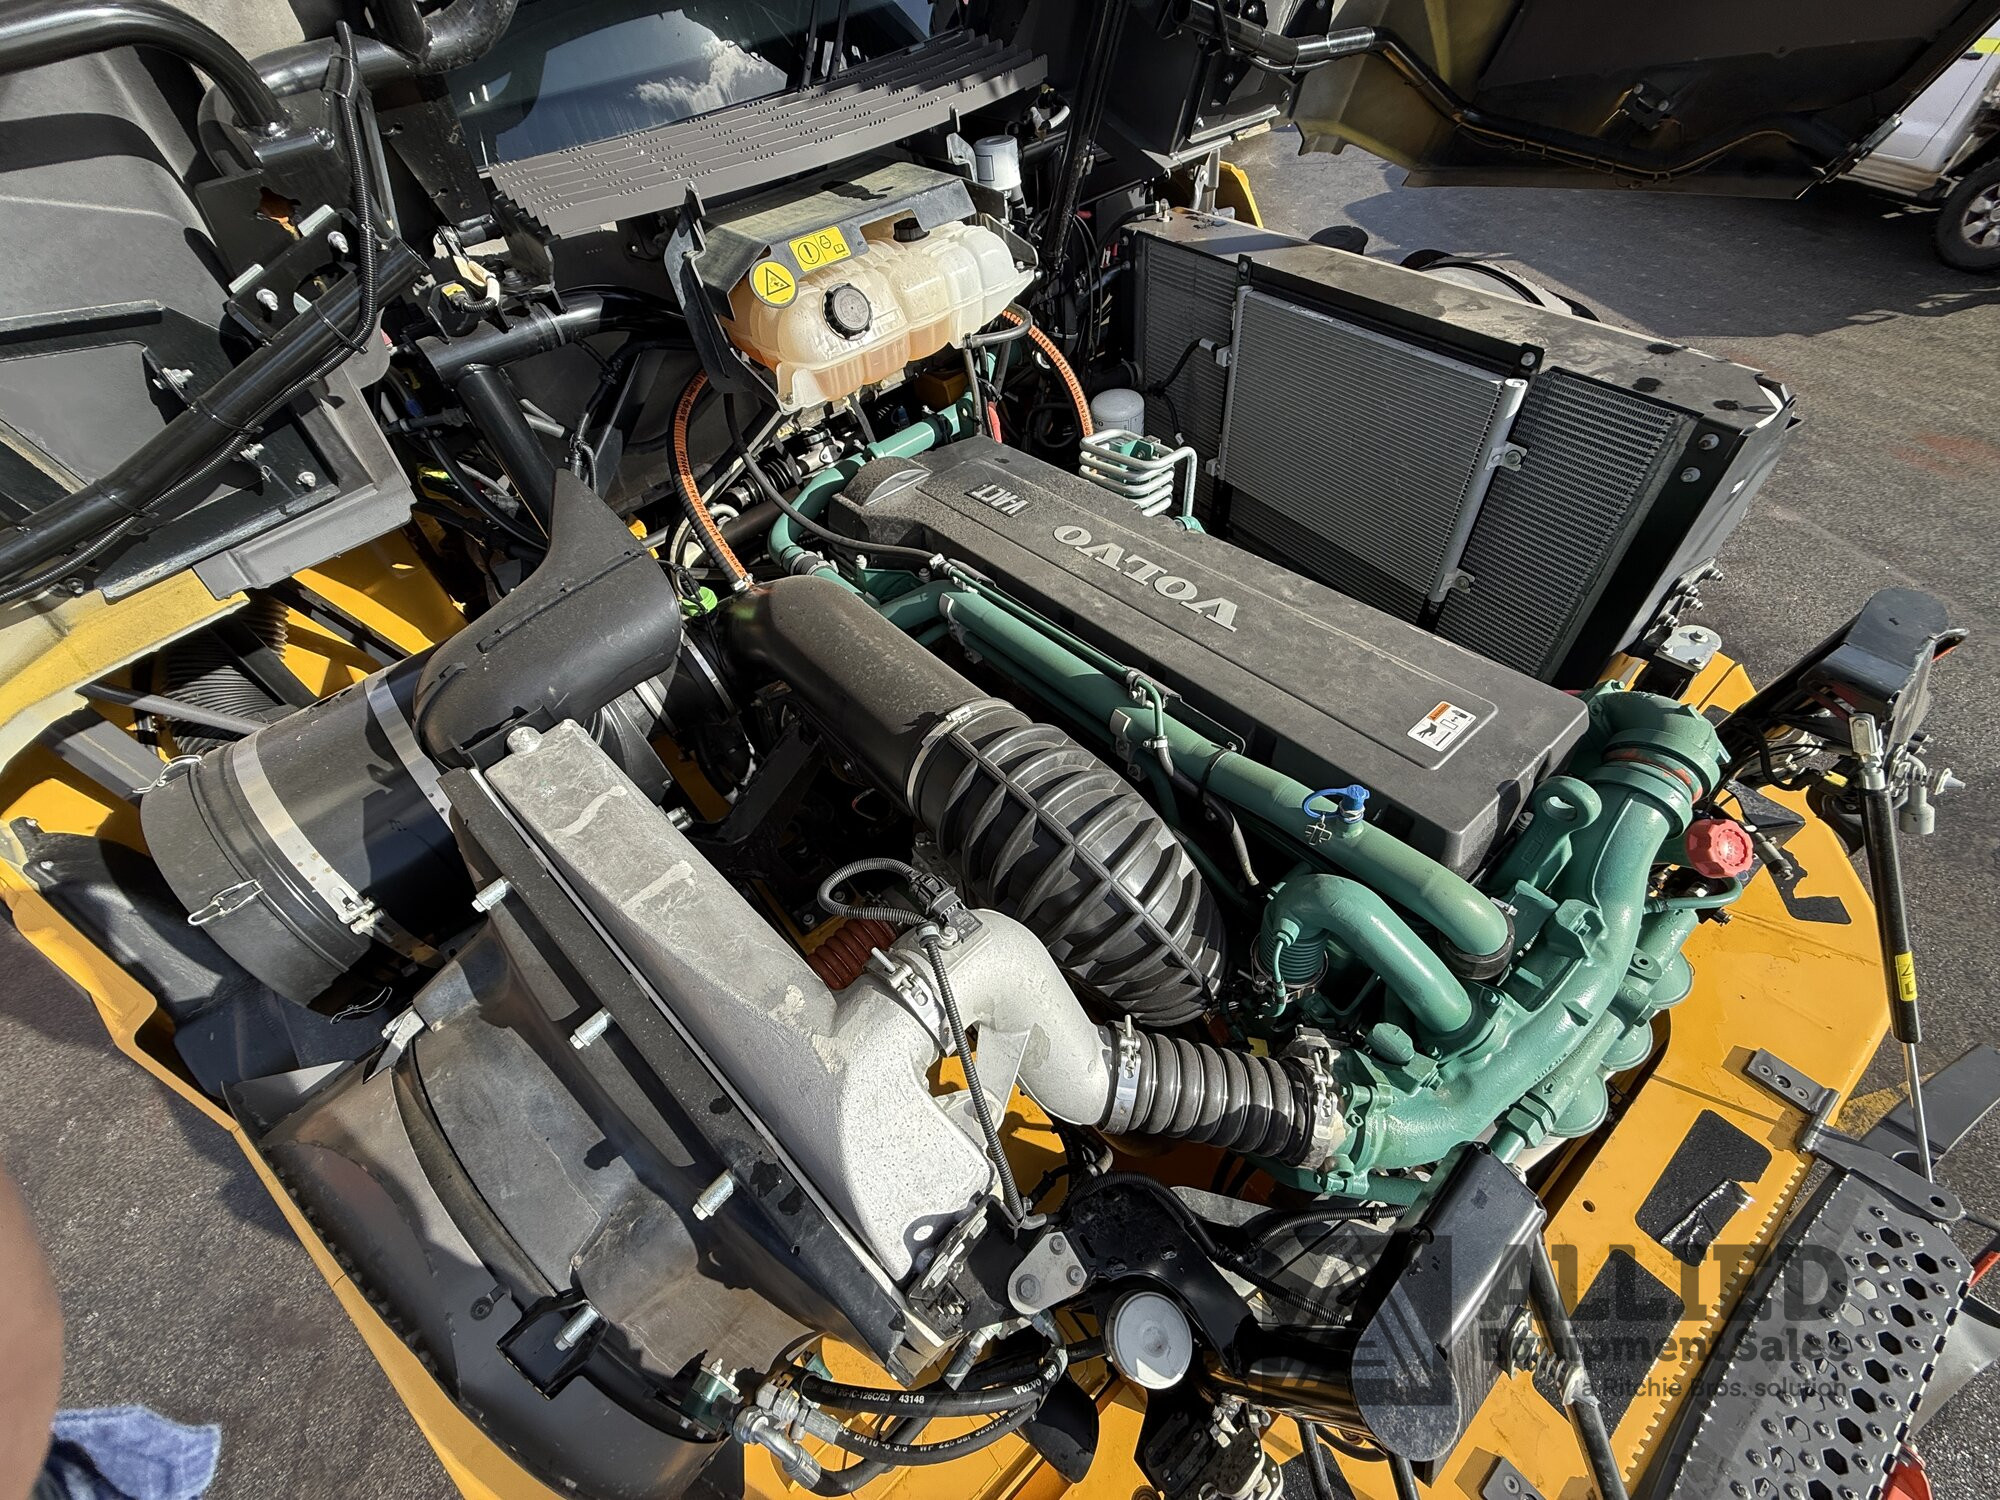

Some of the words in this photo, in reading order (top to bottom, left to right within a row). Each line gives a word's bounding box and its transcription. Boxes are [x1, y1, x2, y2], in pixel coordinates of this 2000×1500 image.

[971, 484, 1029, 515] V-ACT
[1052, 524, 1238, 633] VOLVO
[898, 1393, 925, 1405] 43148
[1012, 1378, 1042, 1396] VOLVO
